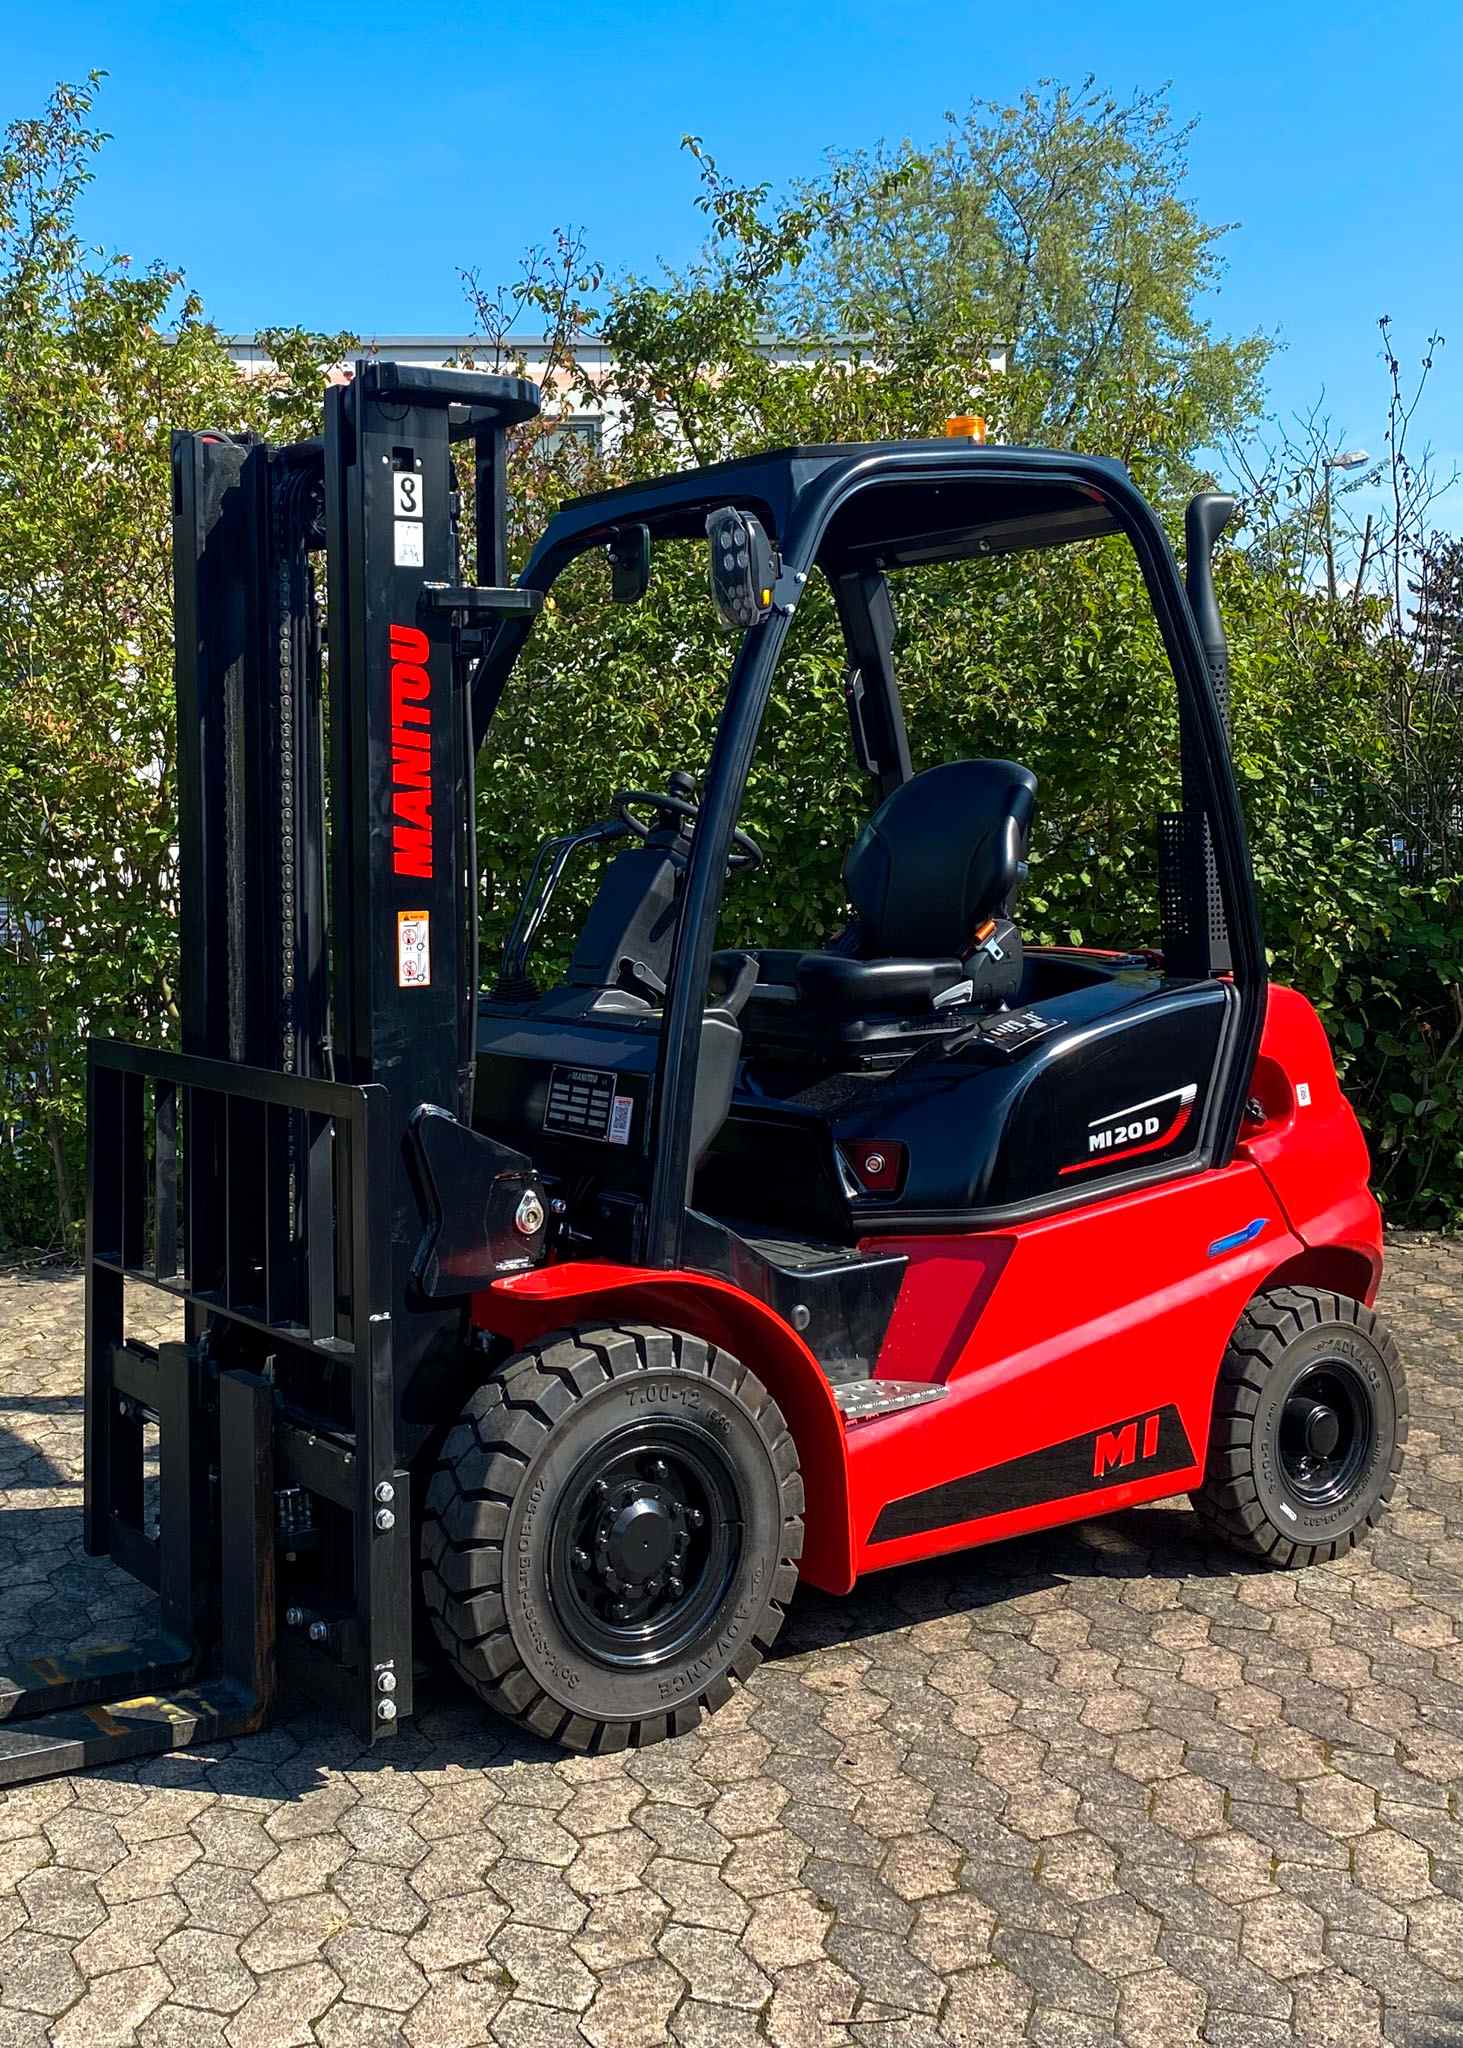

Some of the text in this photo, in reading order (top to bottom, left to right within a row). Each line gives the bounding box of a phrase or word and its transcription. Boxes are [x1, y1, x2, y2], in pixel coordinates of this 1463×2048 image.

[390, 624, 433, 878] MANITOU
[1088, 1117, 1160, 1152] MI20D
[625, 1383, 701, 1410] 7.00-12
[1093, 1414, 1160, 1478] MI
